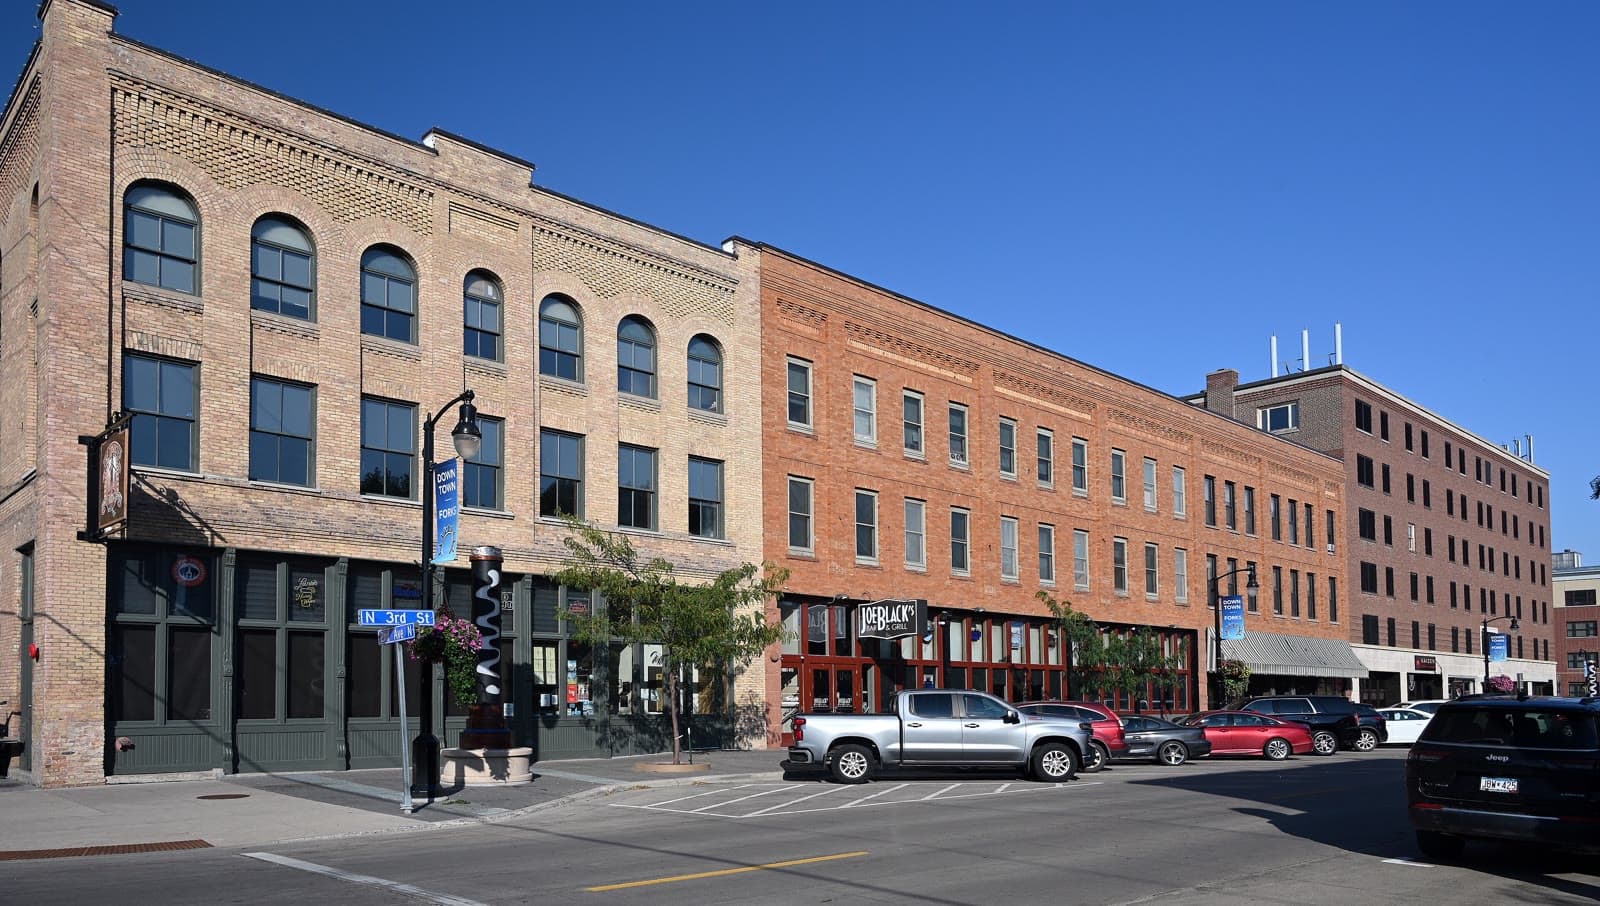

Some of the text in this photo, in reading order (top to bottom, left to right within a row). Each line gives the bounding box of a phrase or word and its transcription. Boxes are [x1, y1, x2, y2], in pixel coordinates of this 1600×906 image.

[437, 469, 456, 483] DOWN
[439, 482, 456, 494] TOWN
[439, 506, 457, 519] FORKS
[365, 611, 430, 624] N 3rd St
[394, 629, 404, 640] Ave
[407, 625, 413, 637] N
[891, 623, 908, 631] GRILL
[1485, 754, 1509, 762] Jeep
